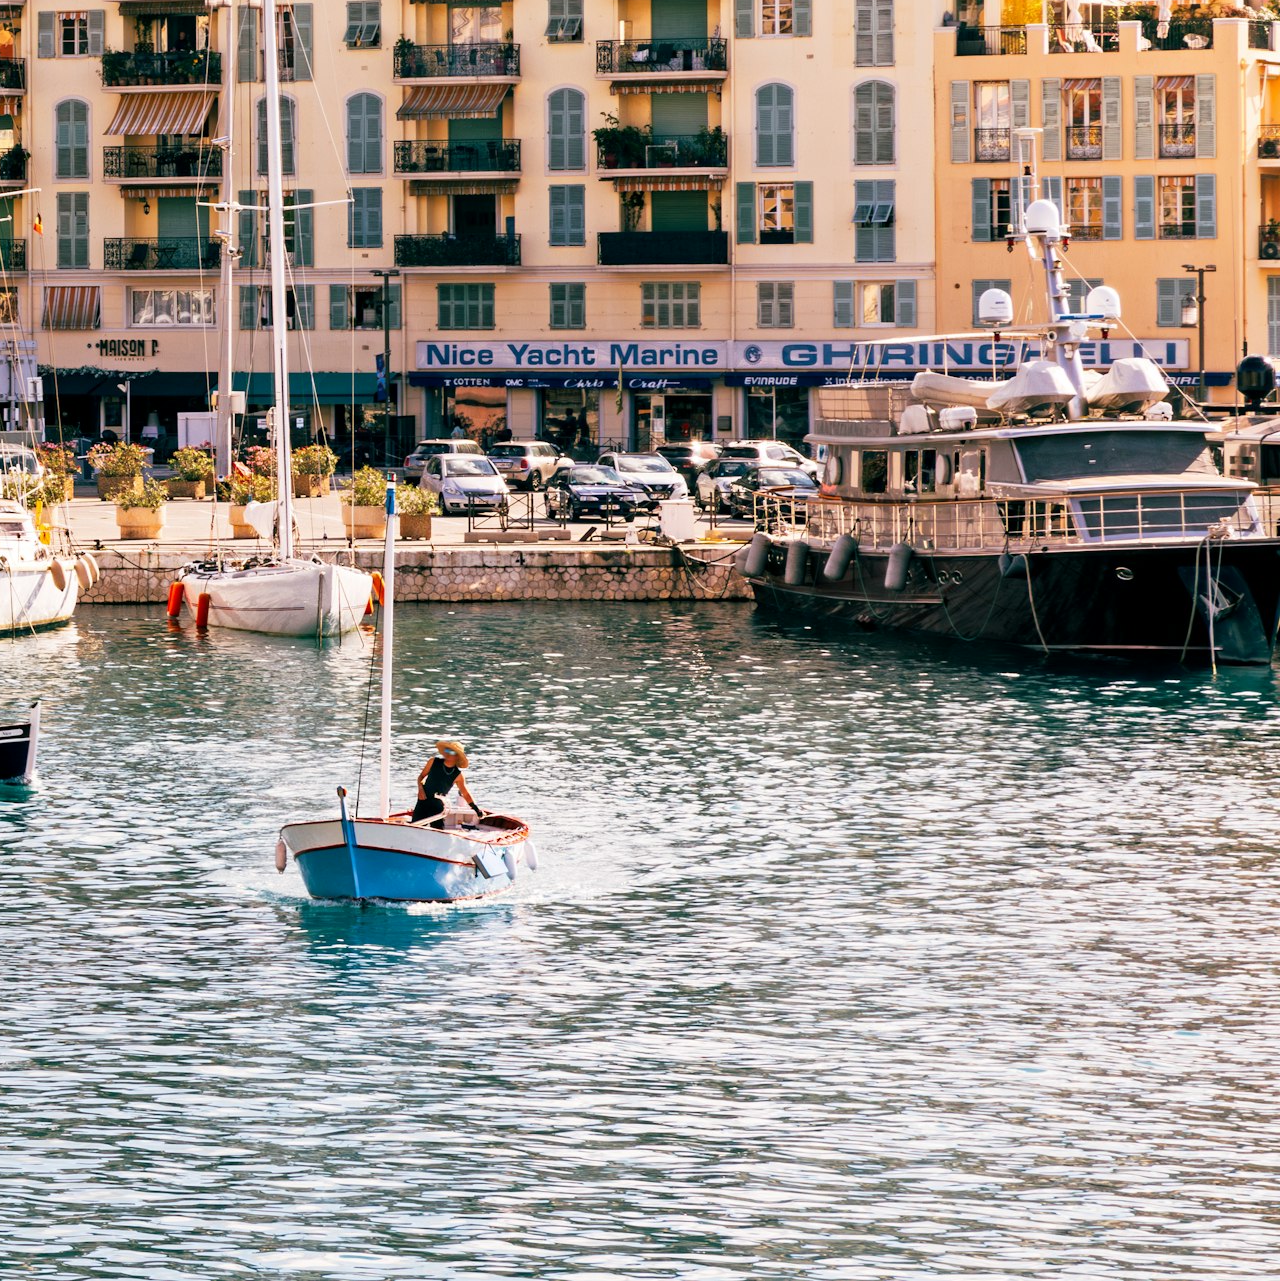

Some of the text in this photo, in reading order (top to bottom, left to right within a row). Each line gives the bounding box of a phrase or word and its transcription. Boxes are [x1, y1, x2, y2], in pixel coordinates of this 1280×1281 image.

[100, 340, 145, 356] MAISON
[426, 344, 718, 365] Nice Yacht Marine
[453, 378, 491, 386] COTTEN
[564, 378, 681, 389] Chris Craft
[744, 376, 798, 385] EVINRUDE
